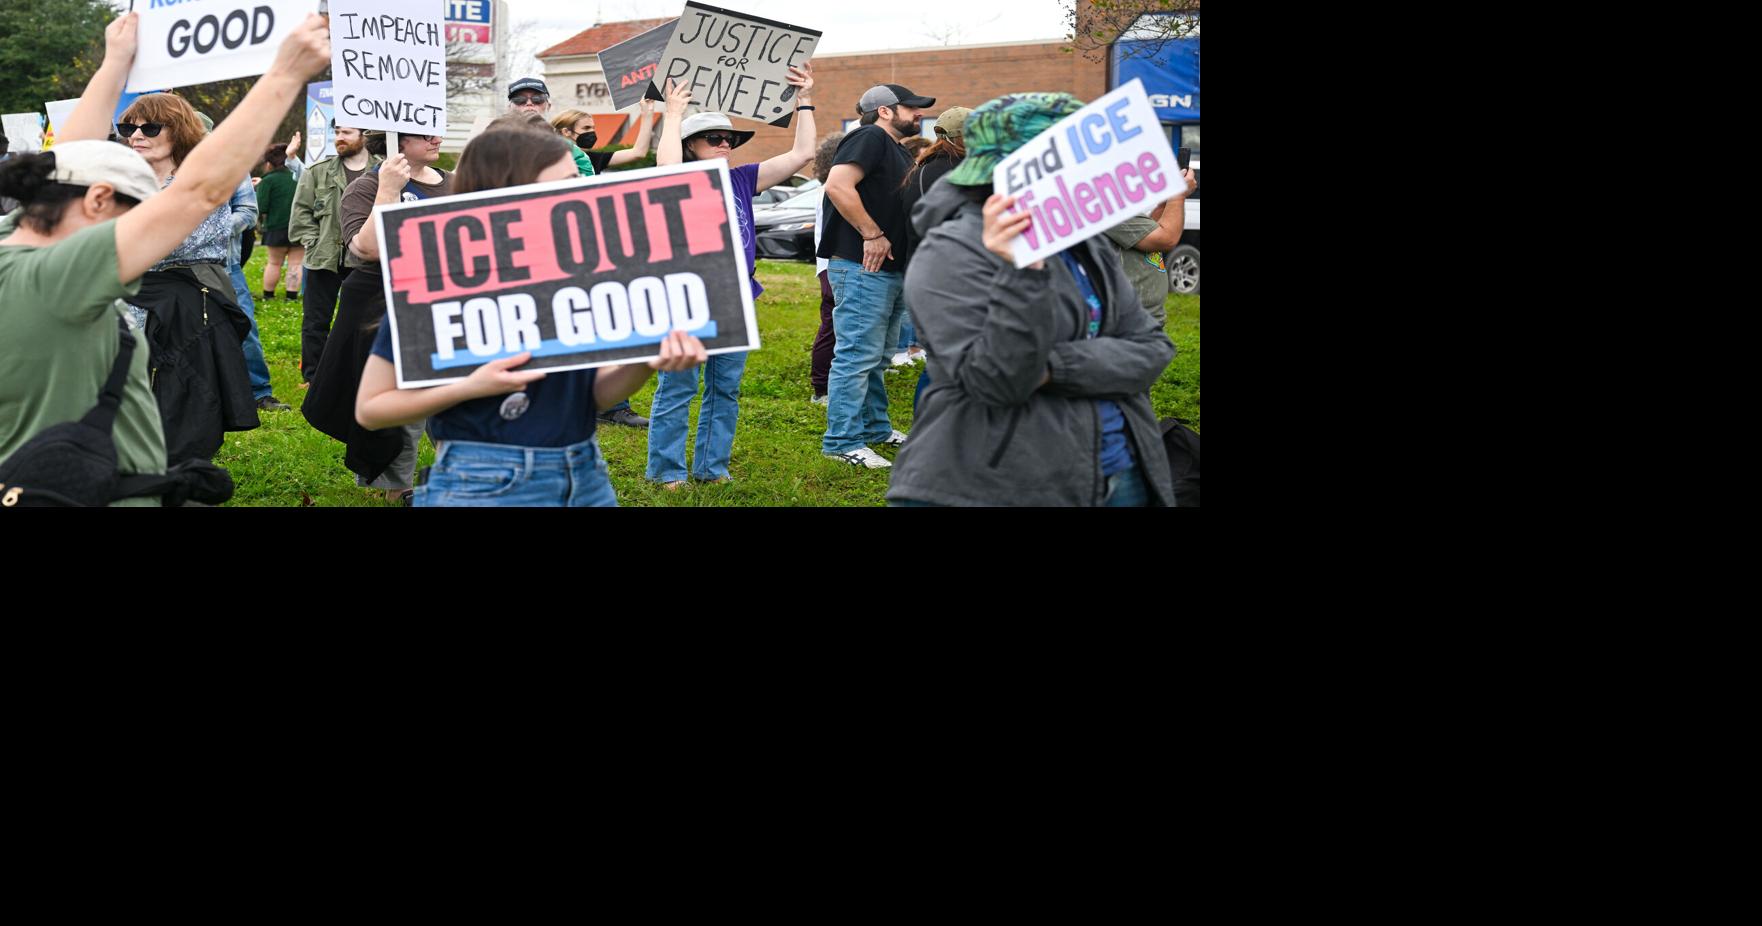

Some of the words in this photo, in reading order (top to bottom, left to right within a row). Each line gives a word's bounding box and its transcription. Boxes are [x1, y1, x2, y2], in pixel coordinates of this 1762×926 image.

[167, 5, 275, 58] GOOD
[340, 13, 439, 46] IMPEACH
[680, 12, 814, 68] JUSTICE
[342, 49, 440, 87] REMOVE
[717, 55, 749, 71] FOR
[342, 94, 443, 128] CONVICT
[1006, 136, 1064, 194] End
[1066, 96, 1143, 164] ICE
[1007, 151, 1167, 251] Violence
[418, 209, 531, 292] ICE
[550, 184, 693, 275] OUT
[431, 293, 541, 360] FOR
[552, 272, 710, 347] GOOD
